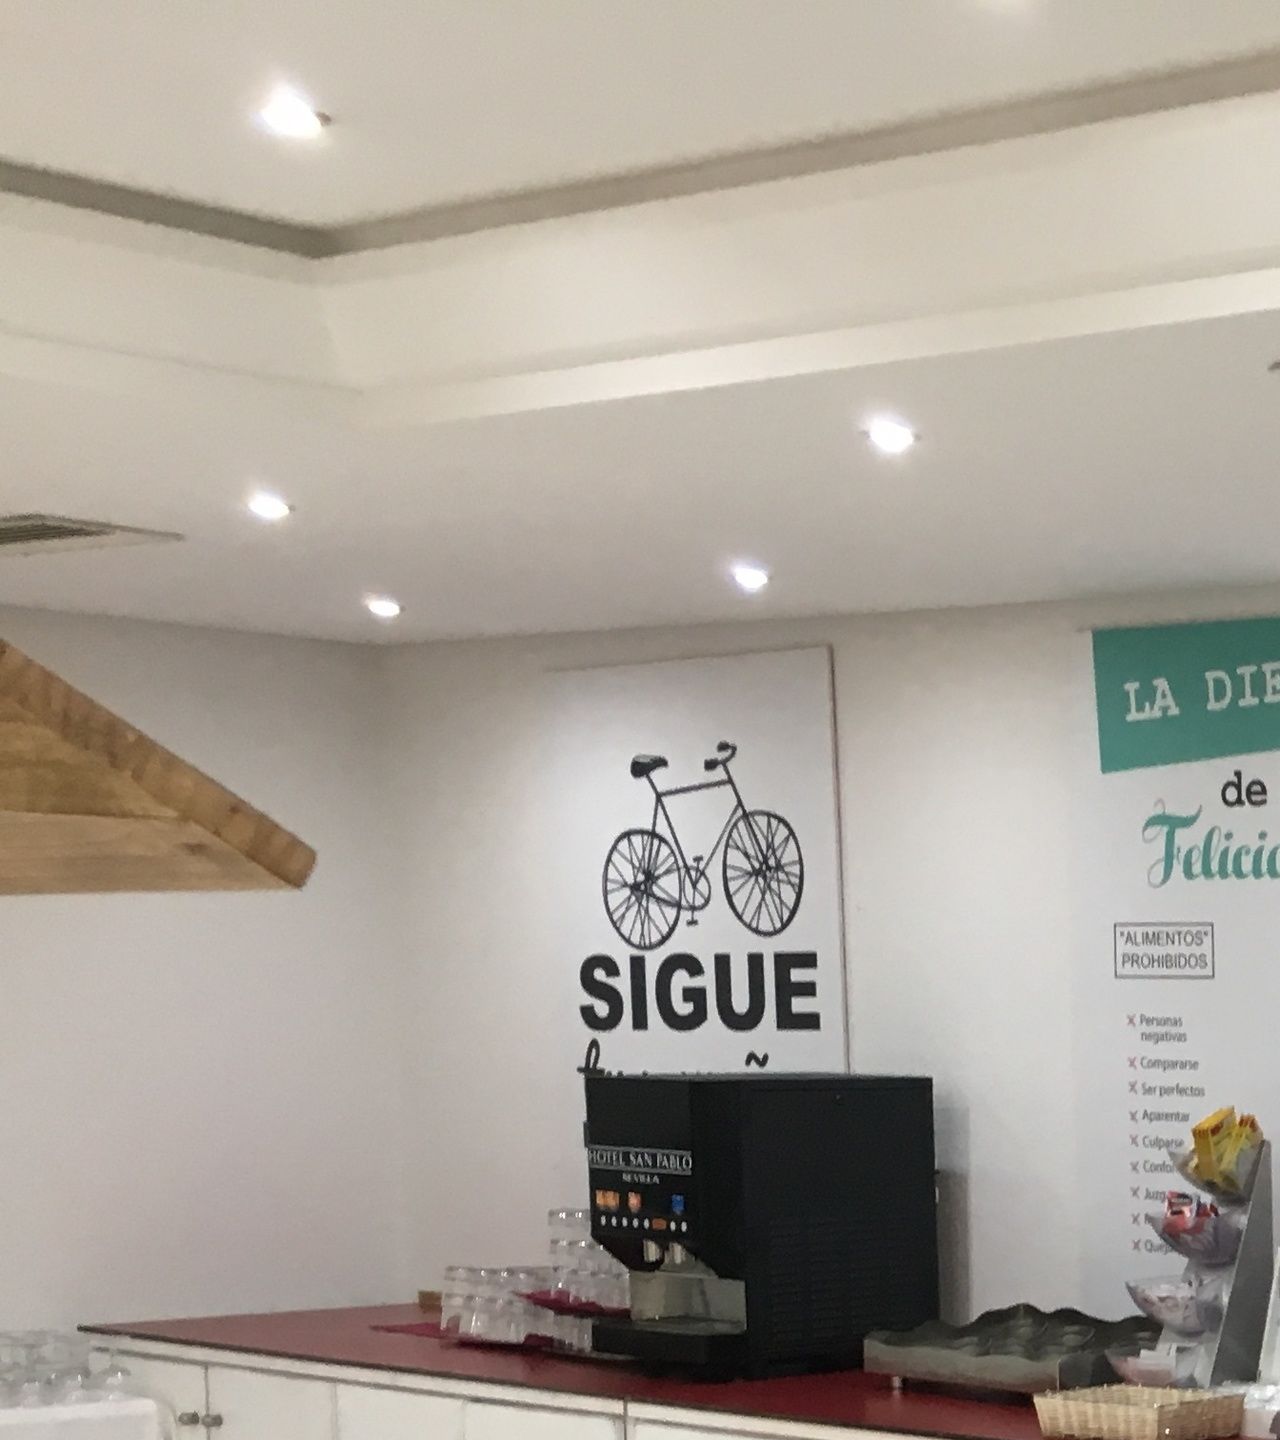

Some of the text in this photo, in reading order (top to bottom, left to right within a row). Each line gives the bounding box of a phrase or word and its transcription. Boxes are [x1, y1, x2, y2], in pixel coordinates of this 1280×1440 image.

[1123, 677, 1180, 722] LA
[1221, 770, 1268, 807] de
[1120, 929, 1209, 947] "ALIMENTOS"
[1121, 952, 1208, 970] PROHIBIDOS
[579, 951, 822, 1031] SIGUE
[1140, 1013, 1183, 1028] Personas
[1140, 1031, 1187, 1045] negativas
[1140, 1056, 1199, 1073] Compararse
[1141, 1082, 1205, 1098] Ser perfectos
[1142, 1109, 1190, 1123] Aparentar
[1142, 1135, 1185, 1150] Culparse
[589, 1149, 693, 1170] HOTEL SAN PABLO
